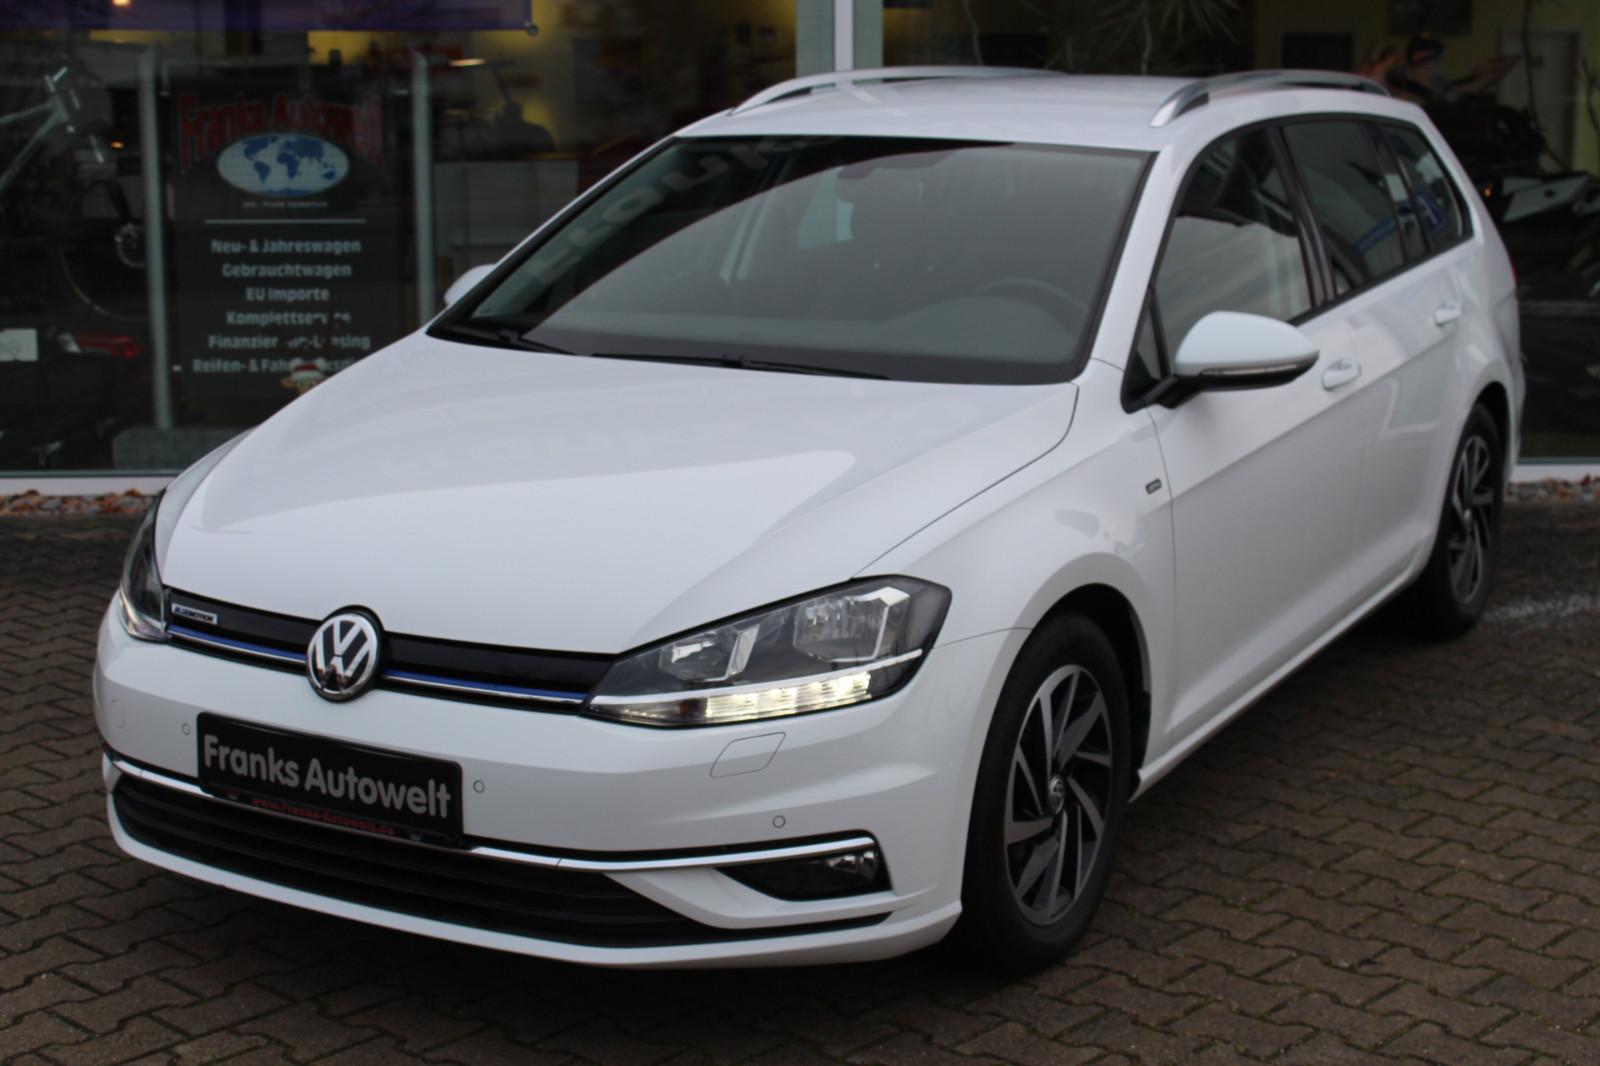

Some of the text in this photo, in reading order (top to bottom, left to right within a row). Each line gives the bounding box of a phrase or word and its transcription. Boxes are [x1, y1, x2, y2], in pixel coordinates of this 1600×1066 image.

[210, 239, 362, 256] Neu- & Jahreswagen
[222, 263, 352, 279] Gebrauchtwagen
[245, 288, 330, 303] EU Importe
[192, 357, 246, 373] Reifen-
[248, 357, 259, 373] &
[203, 734, 451, 819] Franks Autowelt
